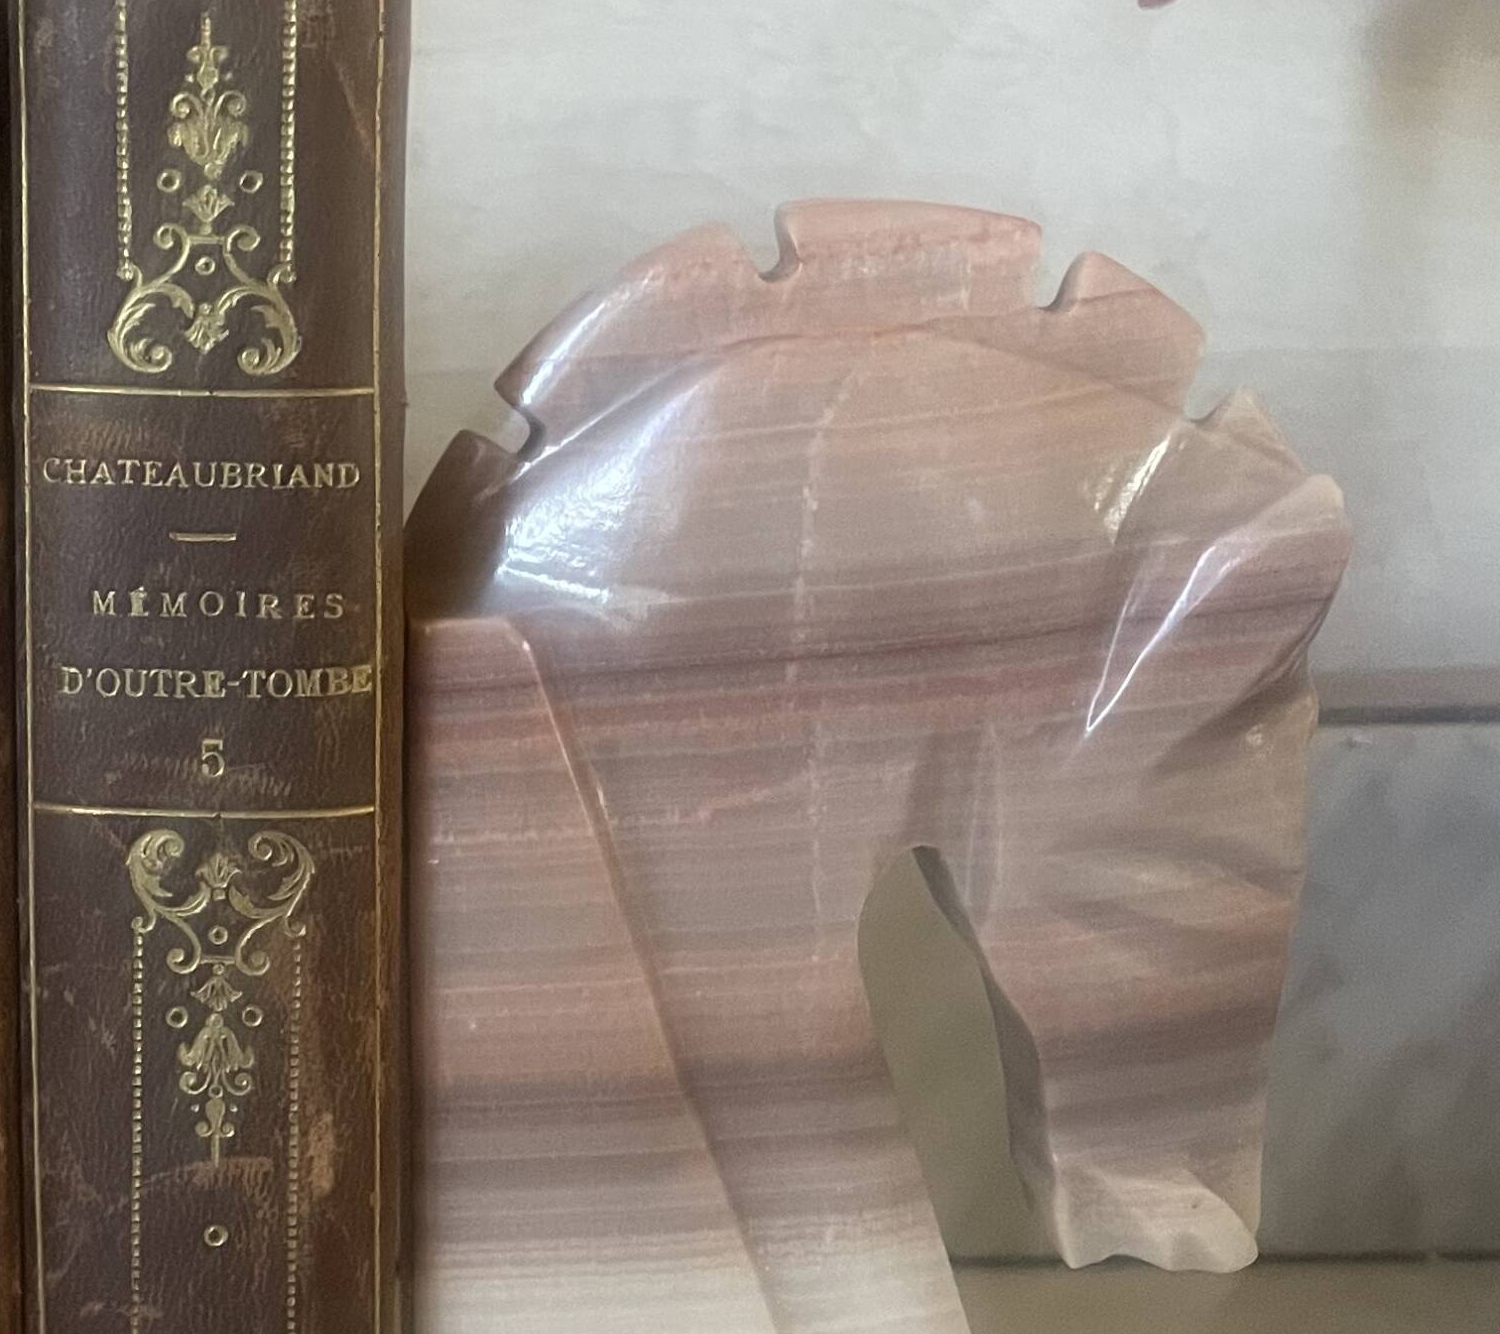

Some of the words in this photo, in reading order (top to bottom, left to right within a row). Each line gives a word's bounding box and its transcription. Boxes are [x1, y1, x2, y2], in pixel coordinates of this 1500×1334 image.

[42, 456, 361, 490] CHATEAUBRIAND
[91, 585, 346, 620] MÉMOIRES
[58, 664, 374, 699] D'OUTRE-TOMBE
[199, 737, 226, 779] 5
